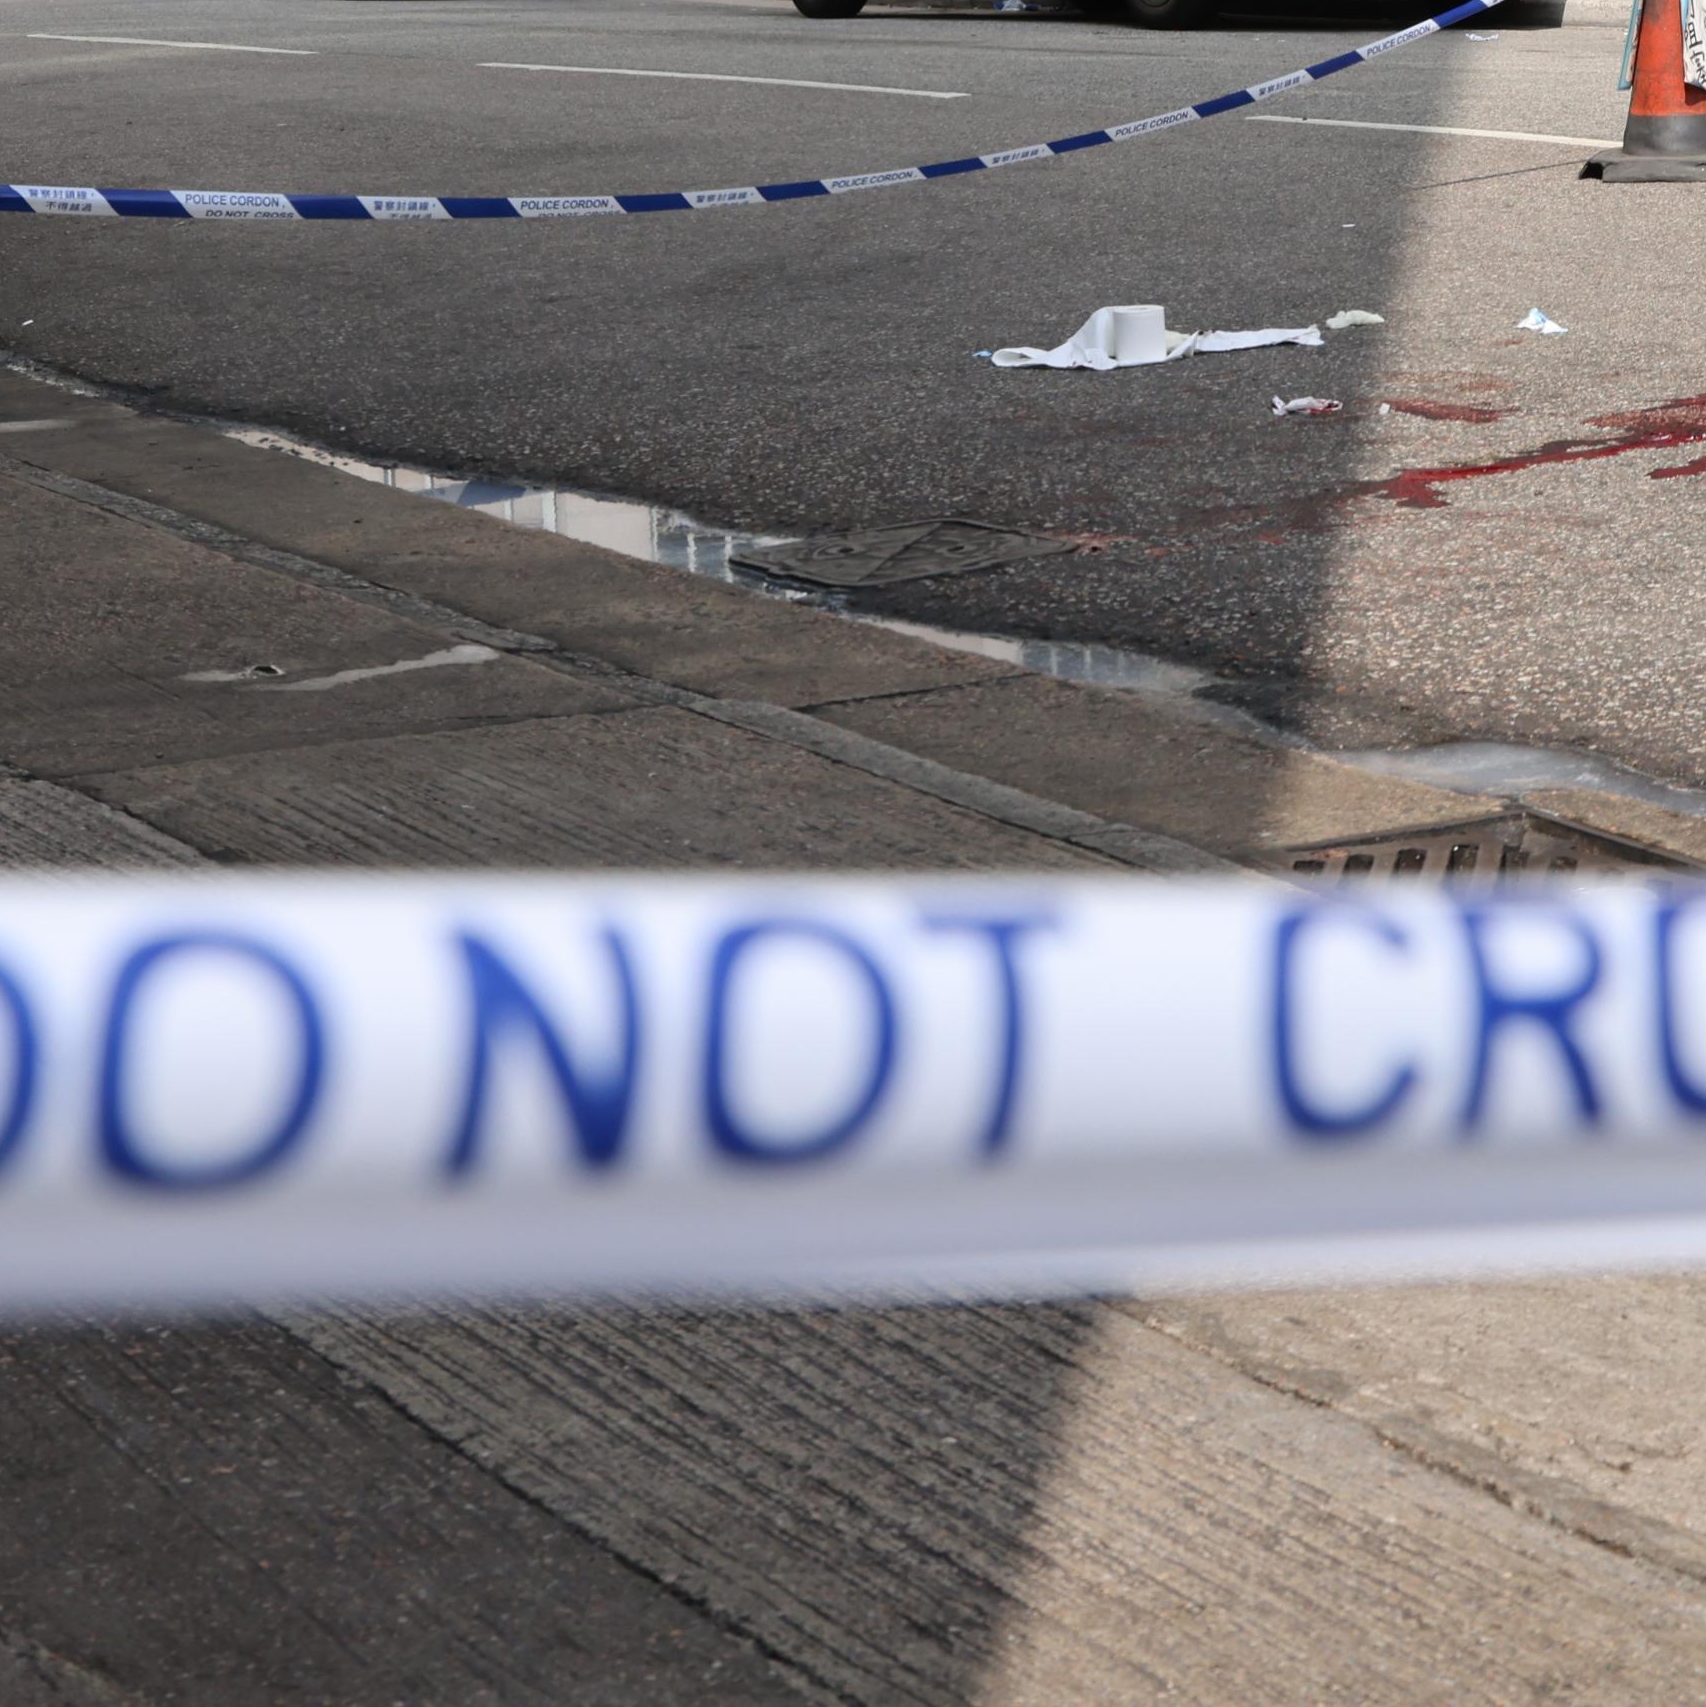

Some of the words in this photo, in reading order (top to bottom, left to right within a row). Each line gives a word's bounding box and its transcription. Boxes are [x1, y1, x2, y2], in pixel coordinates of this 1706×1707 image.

[1366, 37, 1397, 57] POLICE
[1397, 25, 1432, 47] CORDON
[1114, 123, 1149, 137] POLICE
[1149, 111, 1189, 129] CORDON
[831, 178, 868, 190] POLICE
[869, 171, 914, 184] CORDON
[184, 194, 228, 207] POLICE
[230, 193, 280, 208] CORDON
[520, 199, 560, 211] POLICE
[562, 198, 610, 210] CORDON
[205, 209, 224, 218] DO
[225, 209, 250, 218] NOT
[431, 910, 1068, 1168] NOT
